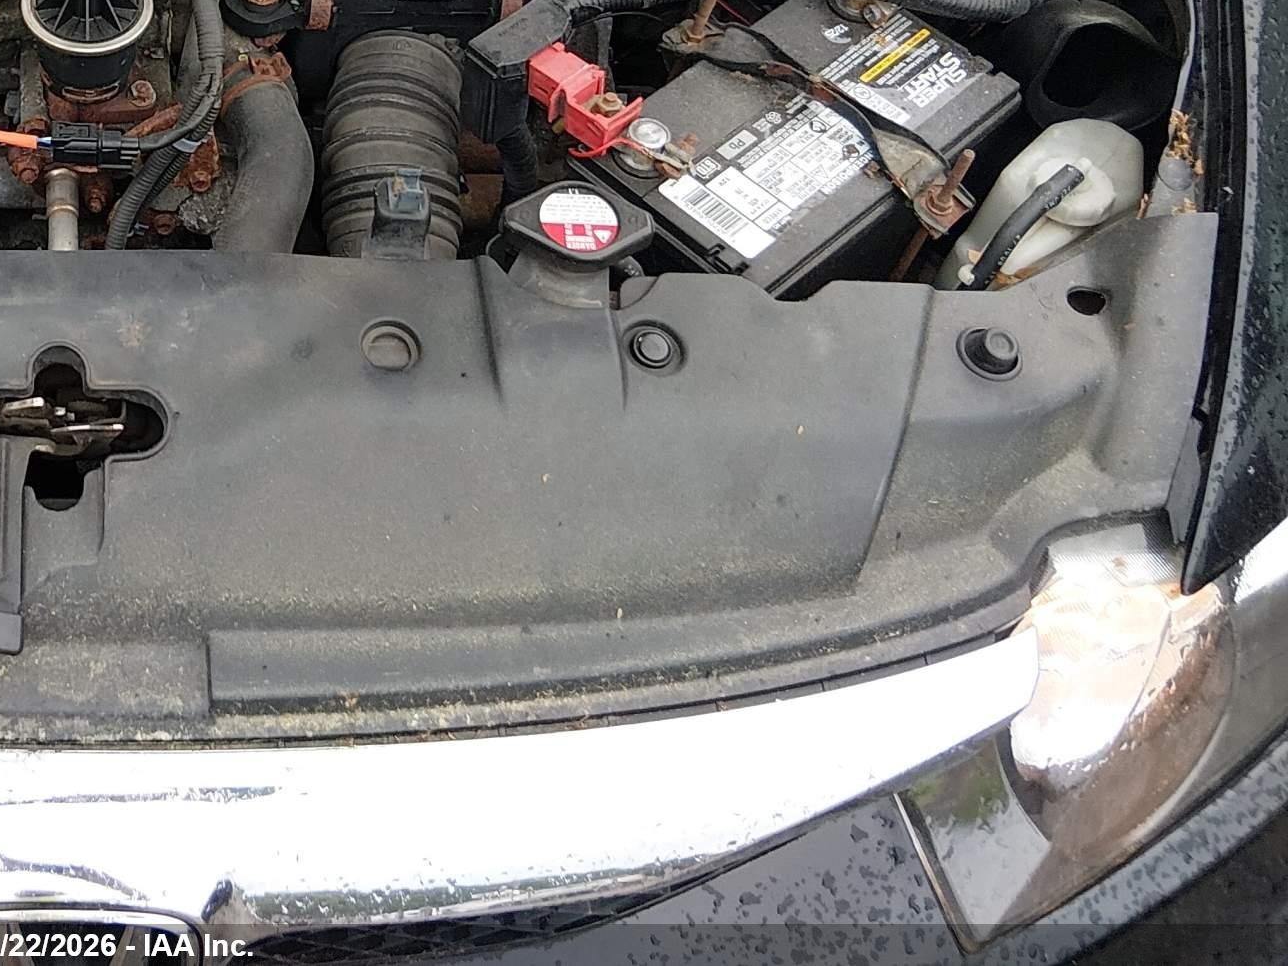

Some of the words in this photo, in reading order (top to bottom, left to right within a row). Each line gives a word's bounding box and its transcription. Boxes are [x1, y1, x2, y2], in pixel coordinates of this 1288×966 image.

[904, 51, 961, 100] START
[912, 68, 967, 108] SUPER
[728, 137, 746, 150] Pb
